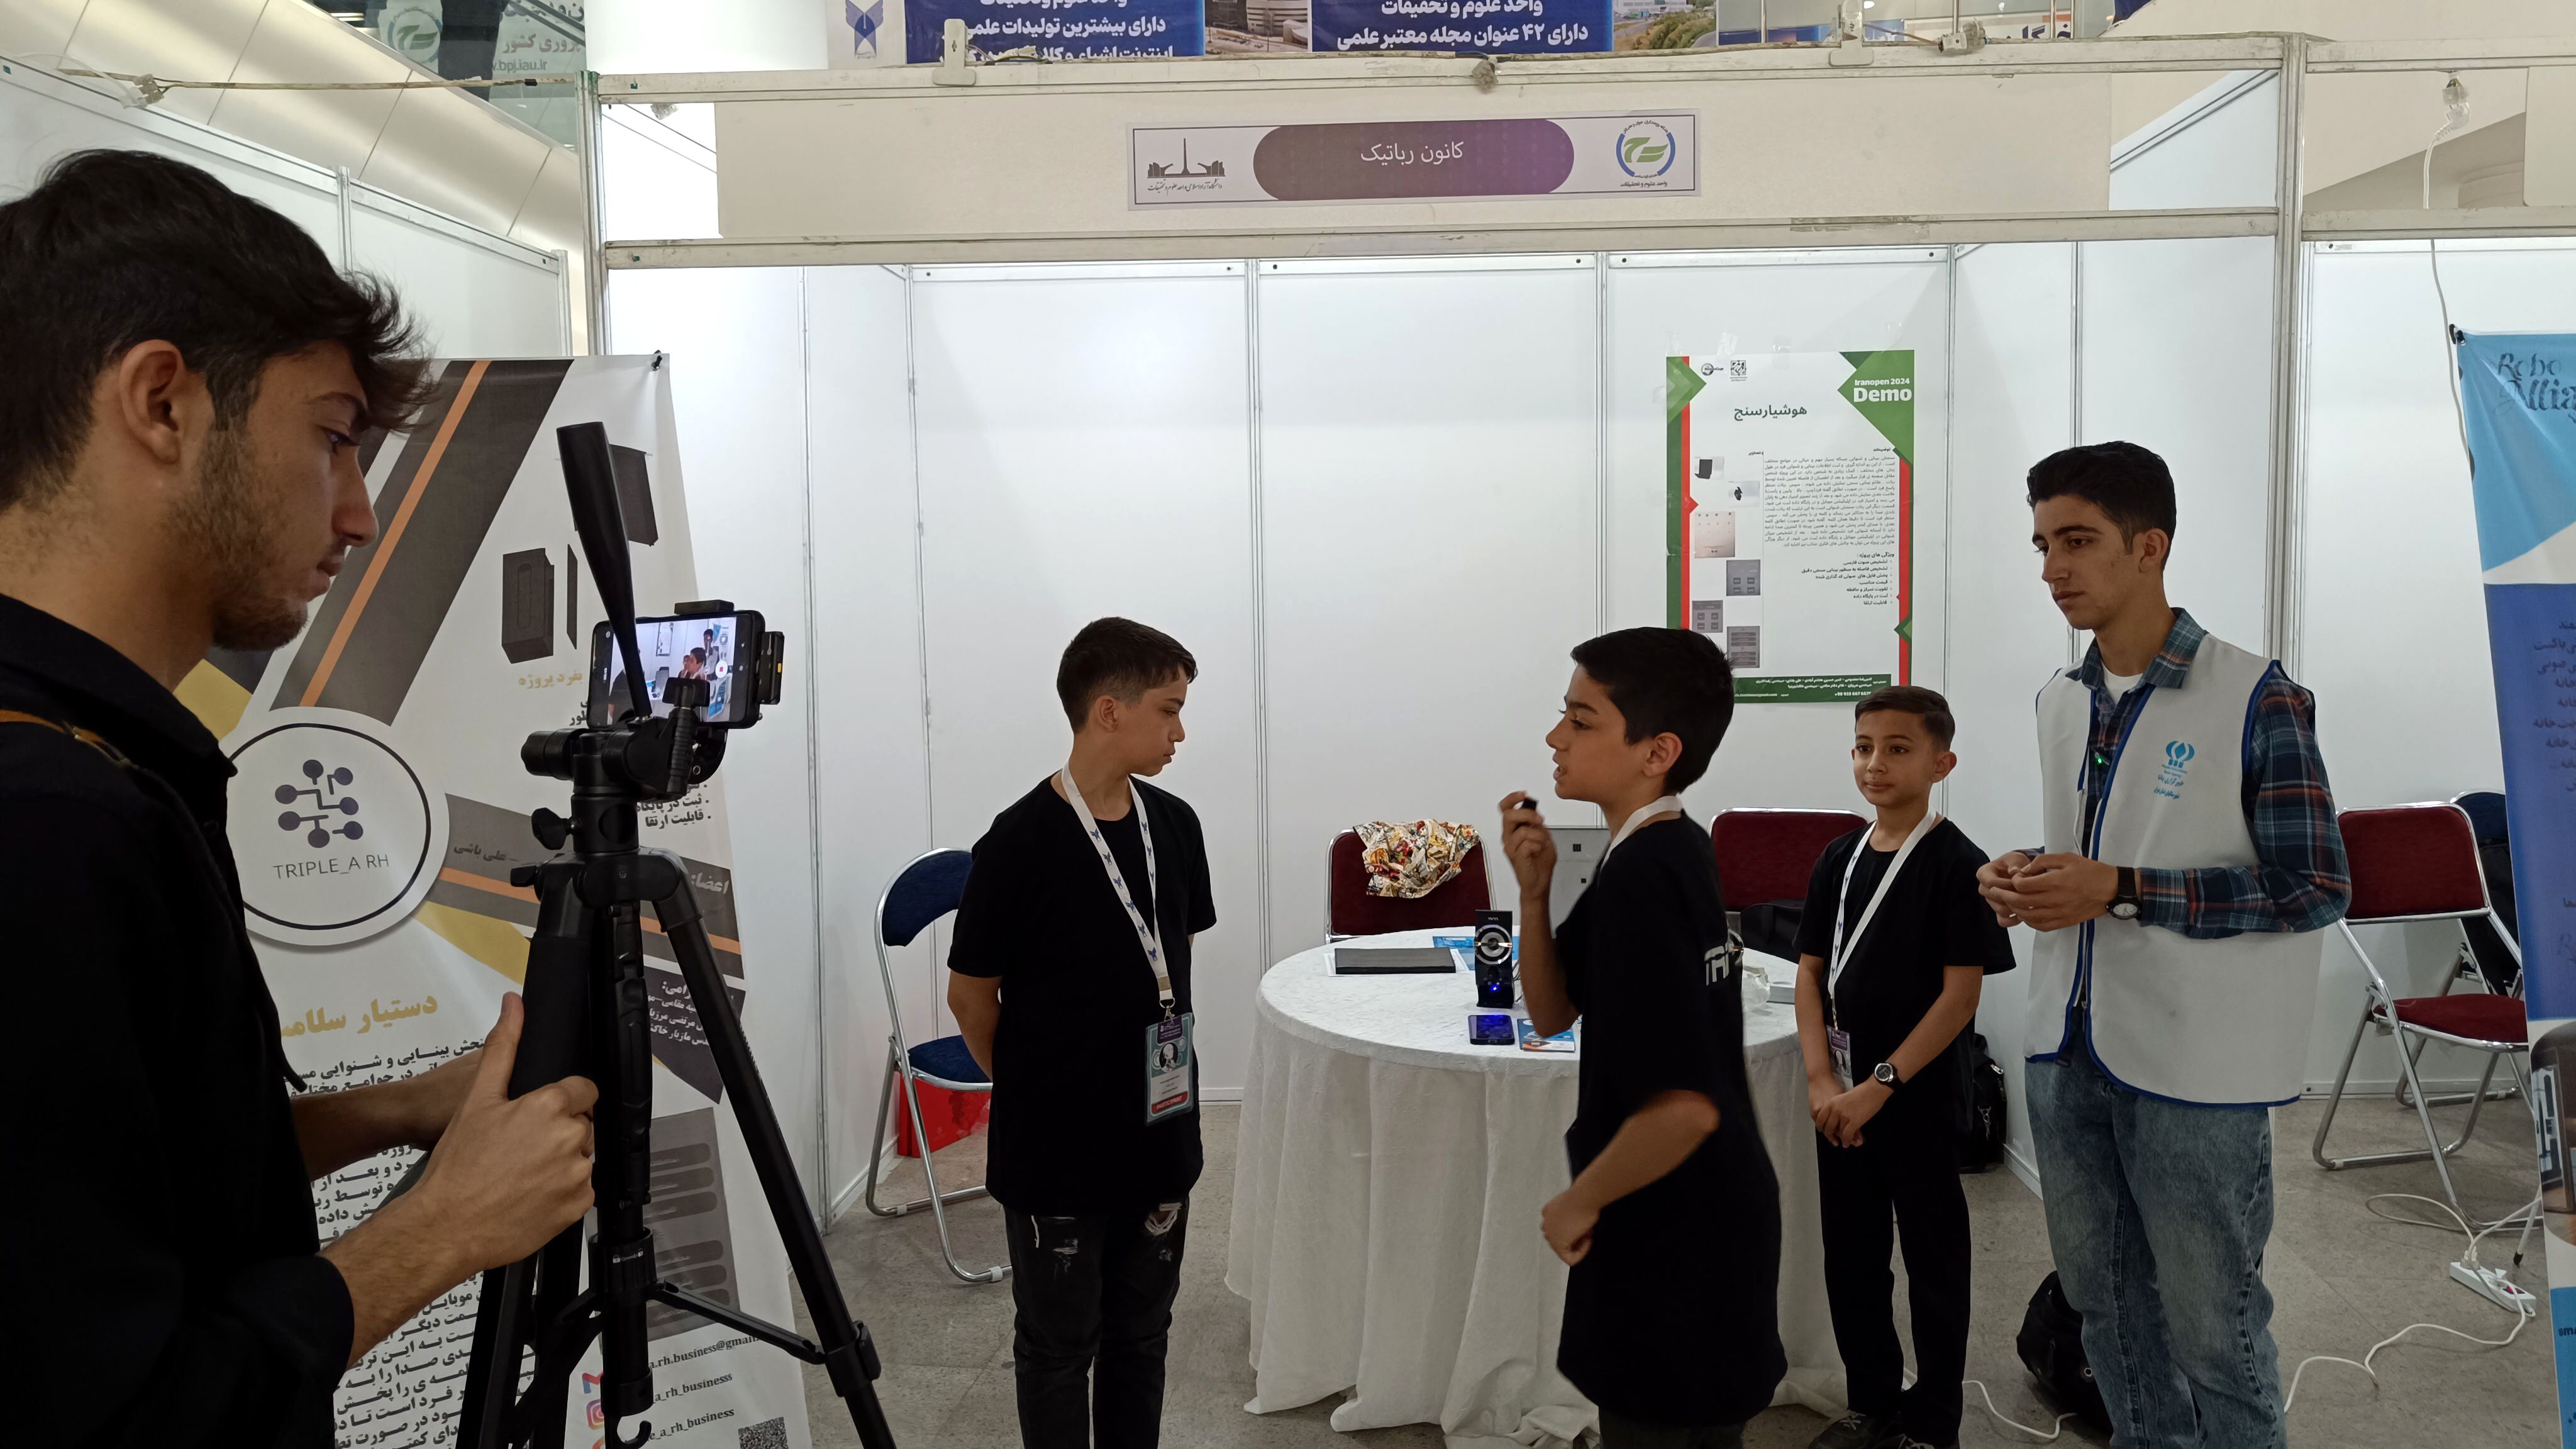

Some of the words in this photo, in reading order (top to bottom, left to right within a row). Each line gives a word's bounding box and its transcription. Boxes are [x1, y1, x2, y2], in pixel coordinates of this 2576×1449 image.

[1003, 18, 1060, 38] تولیدات
[1062, 17, 1126, 38] بیشترین
[1128, 16, 1165, 37] دارای
[1430, 26, 1472, 46] مجله
[1474, 25, 1519, 46] عنوان
[1522, 23, 1545, 40] ۴۲
[1548, 23, 1588, 45] دارای
[1337, 28, 1379, 50] علمی
[1380, 28, 1427, 49] معتبر
[1360, 144, 1415, 164] رباتیک
[1421, 141, 1464, 163] کانون
[2498, 353, 2561, 380] Robo
[1853, 387, 1912, 402] Demo
[2492, 379, 2576, 415] Allia
[1734, 404, 1807, 421] هوشیارسنج
[518, 672, 554, 689] پروژه
[682, 793, 702, 808] ثبت
[645, 815, 669, 829] ارتقا
[671, 810, 704, 824] قابلیت
[453, 843, 482, 857] باشی
[483, 848, 507, 863] علی
[273, 857, 361, 880] TRIPLE_A
[366, 853, 390, 870] RH
[282, 1007, 346, 1037] سلام
[357, 996, 438, 1034] دستیار
[649, 1008, 669, 1021] مرزبا
[669, 1030, 691, 1041] مازیار
[387, 1057, 393, 1068] و
[397, 1045, 449, 1065] بینایی
[320, 1055, 382, 1080] شنوایی
[336, 1167, 379, 1184] بعد
[384, 1167, 391, 1177] و
[320, 1174, 331, 1192] از
[335, 1182, 383, 1201] توسط
[319, 1209, 349, 1224] داده
[423, 1292, 472, 1316] موبایل
[398, 1318, 440, 1342] دیگر
[418, 1332, 442, 1349] به
[382, 1340, 414, 1363] این
[648, 1336, 760, 1368] a.rh.business@gmail.
[379, 1368, 392, 1383] را
[395, 1357, 438, 1375] صدا
[430, 1363, 469, 1384] لمه
[346, 1373, 375, 1388] به
[396, 1382, 409, 1397] را
[413, 1379, 426, 1393] ی
[337, 1387, 392, 1415] پخش
[419, 1385, 453, 1409] فرد
[350, 1410, 372, 1426] تا
[375, 1397, 416, 1419] است
[432, 1409, 462, 1424] ود
[355, 1422, 408, 1445] صورت
[413, 1416, 428, 1432] در
[648, 1409, 735, 1441] e_a_rh_business
[433, 1424, 458, 1445] دای
